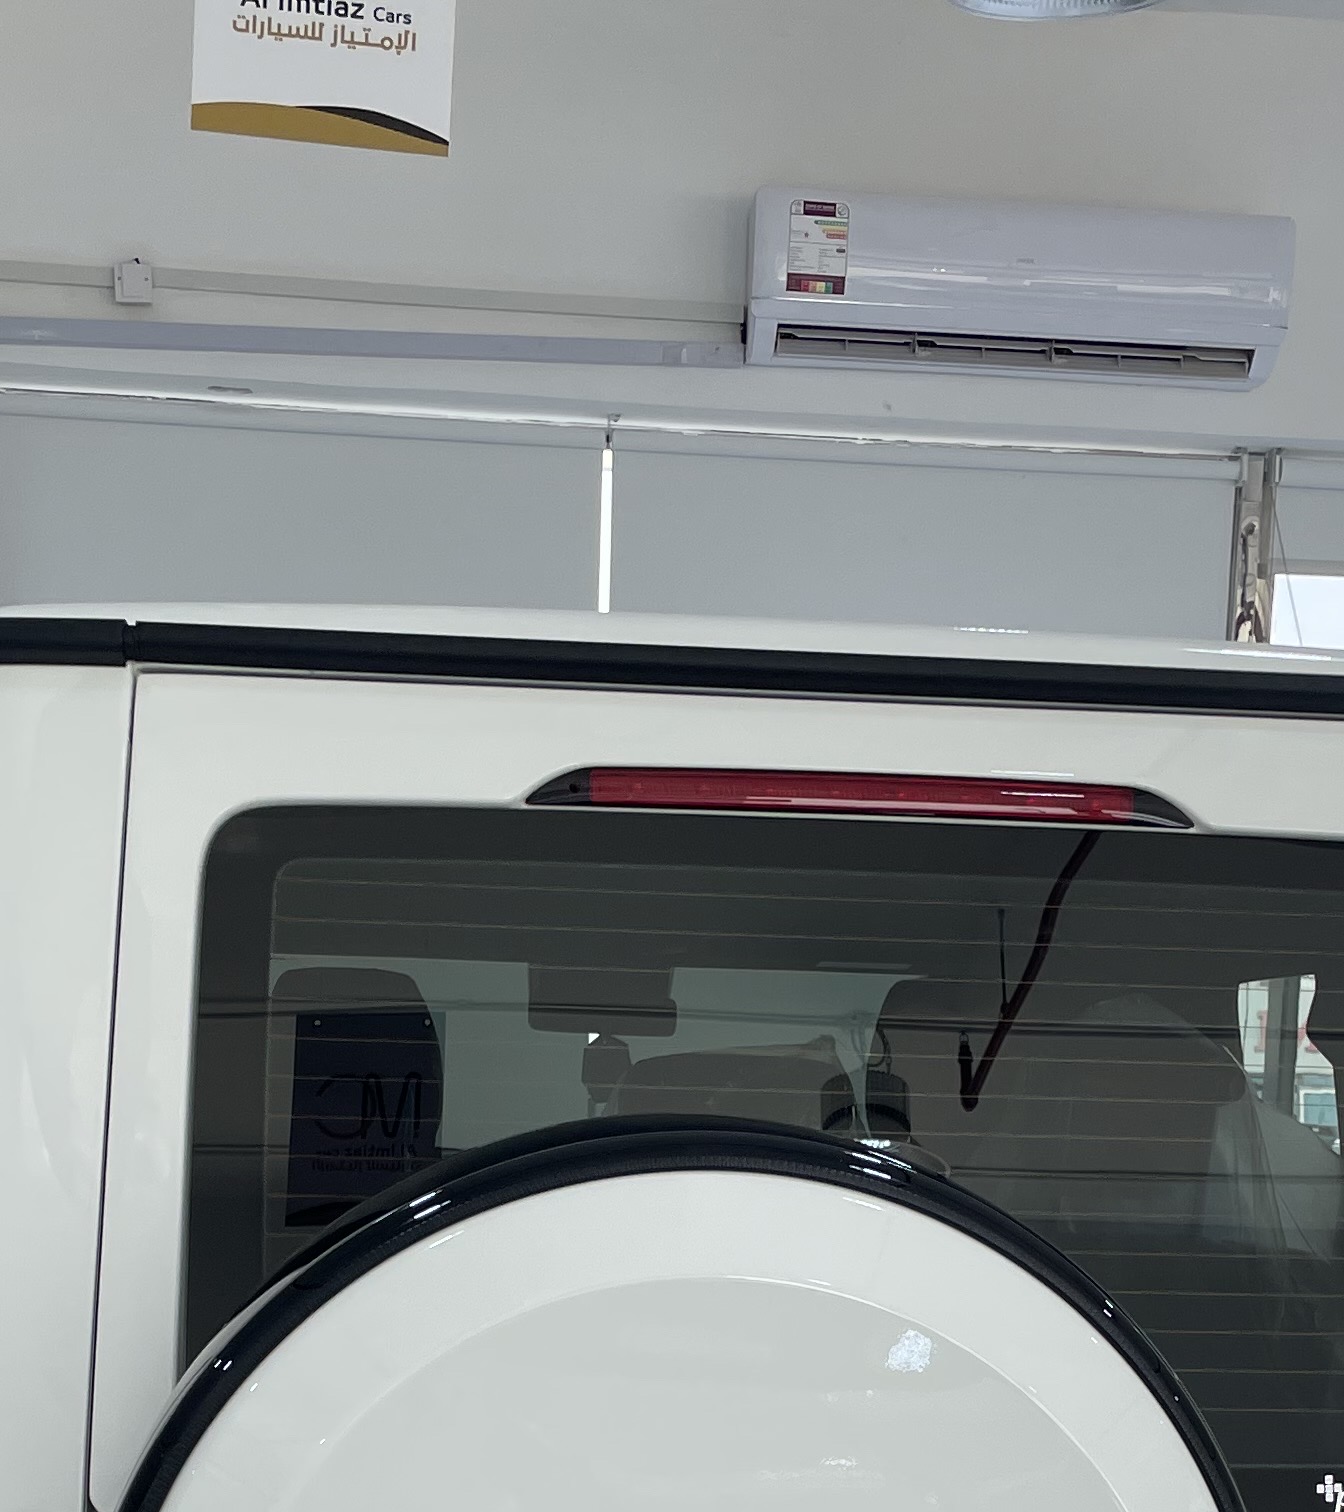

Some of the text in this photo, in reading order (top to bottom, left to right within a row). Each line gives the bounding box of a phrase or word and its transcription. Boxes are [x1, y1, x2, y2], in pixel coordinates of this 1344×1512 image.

[373, 7, 412, 25] Cars
[232, 14, 417, 56] الإمتياز للسيارات
